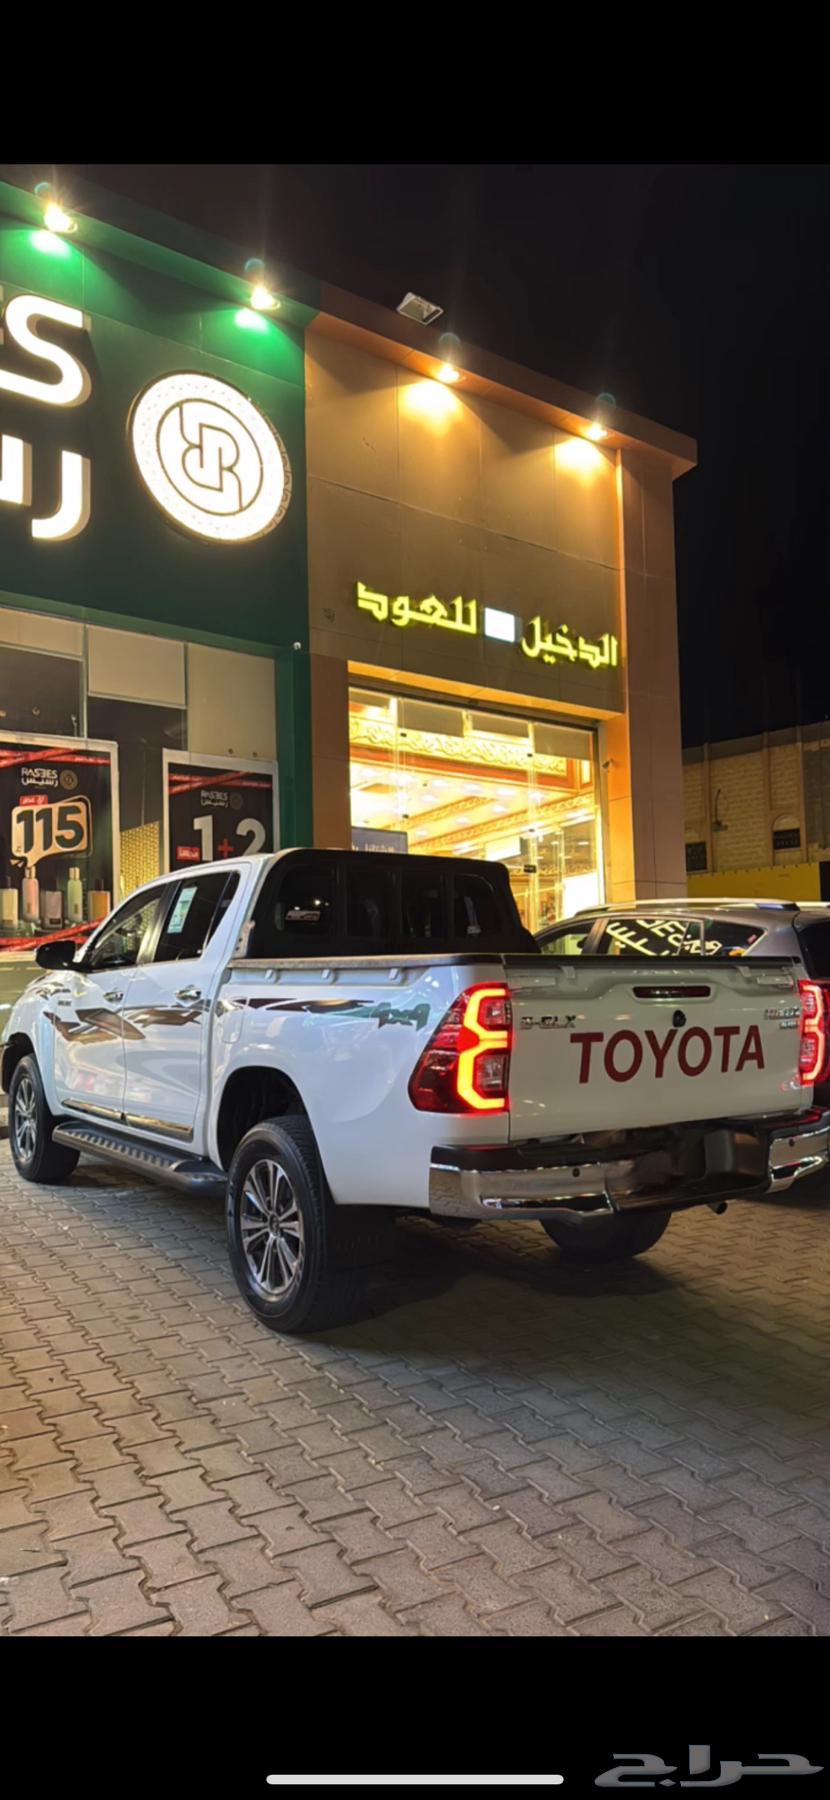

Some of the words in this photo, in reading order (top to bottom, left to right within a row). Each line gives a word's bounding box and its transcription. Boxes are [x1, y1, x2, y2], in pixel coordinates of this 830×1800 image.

[357, 581, 477, 635] للعود
[521, 616, 618, 669] الدخيل
[16, 805, 84, 854] 115
[570, 1024, 765, 1084] TOYOTA
